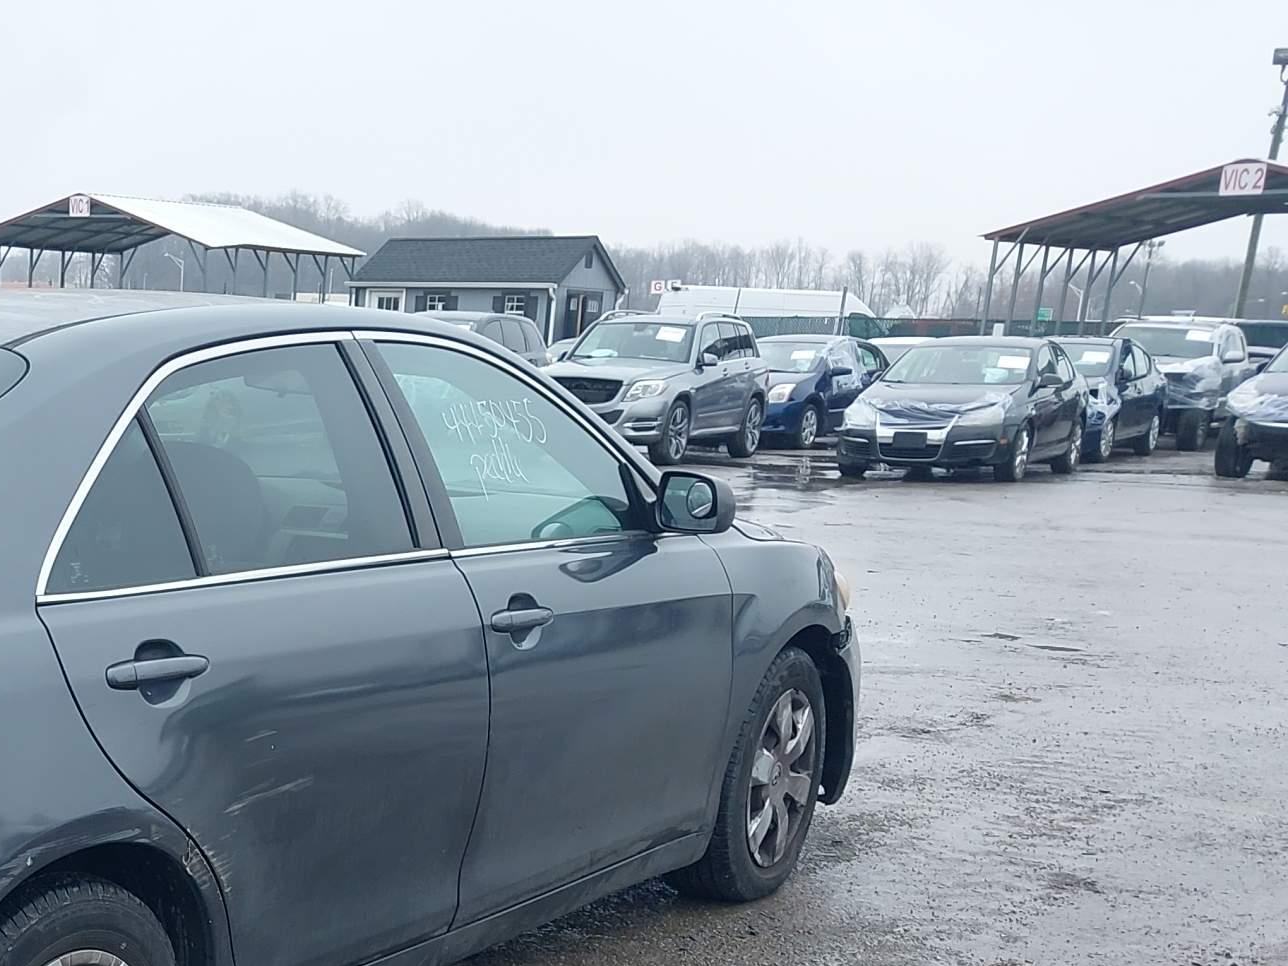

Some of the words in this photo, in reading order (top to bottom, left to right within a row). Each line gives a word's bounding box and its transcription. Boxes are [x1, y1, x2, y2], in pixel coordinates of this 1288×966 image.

[1224, 167, 1250, 191] VIC
[1252, 167, 1264, 189] 2
[70, 198, 84, 214] VIC
[654, 281, 662, 291] G
